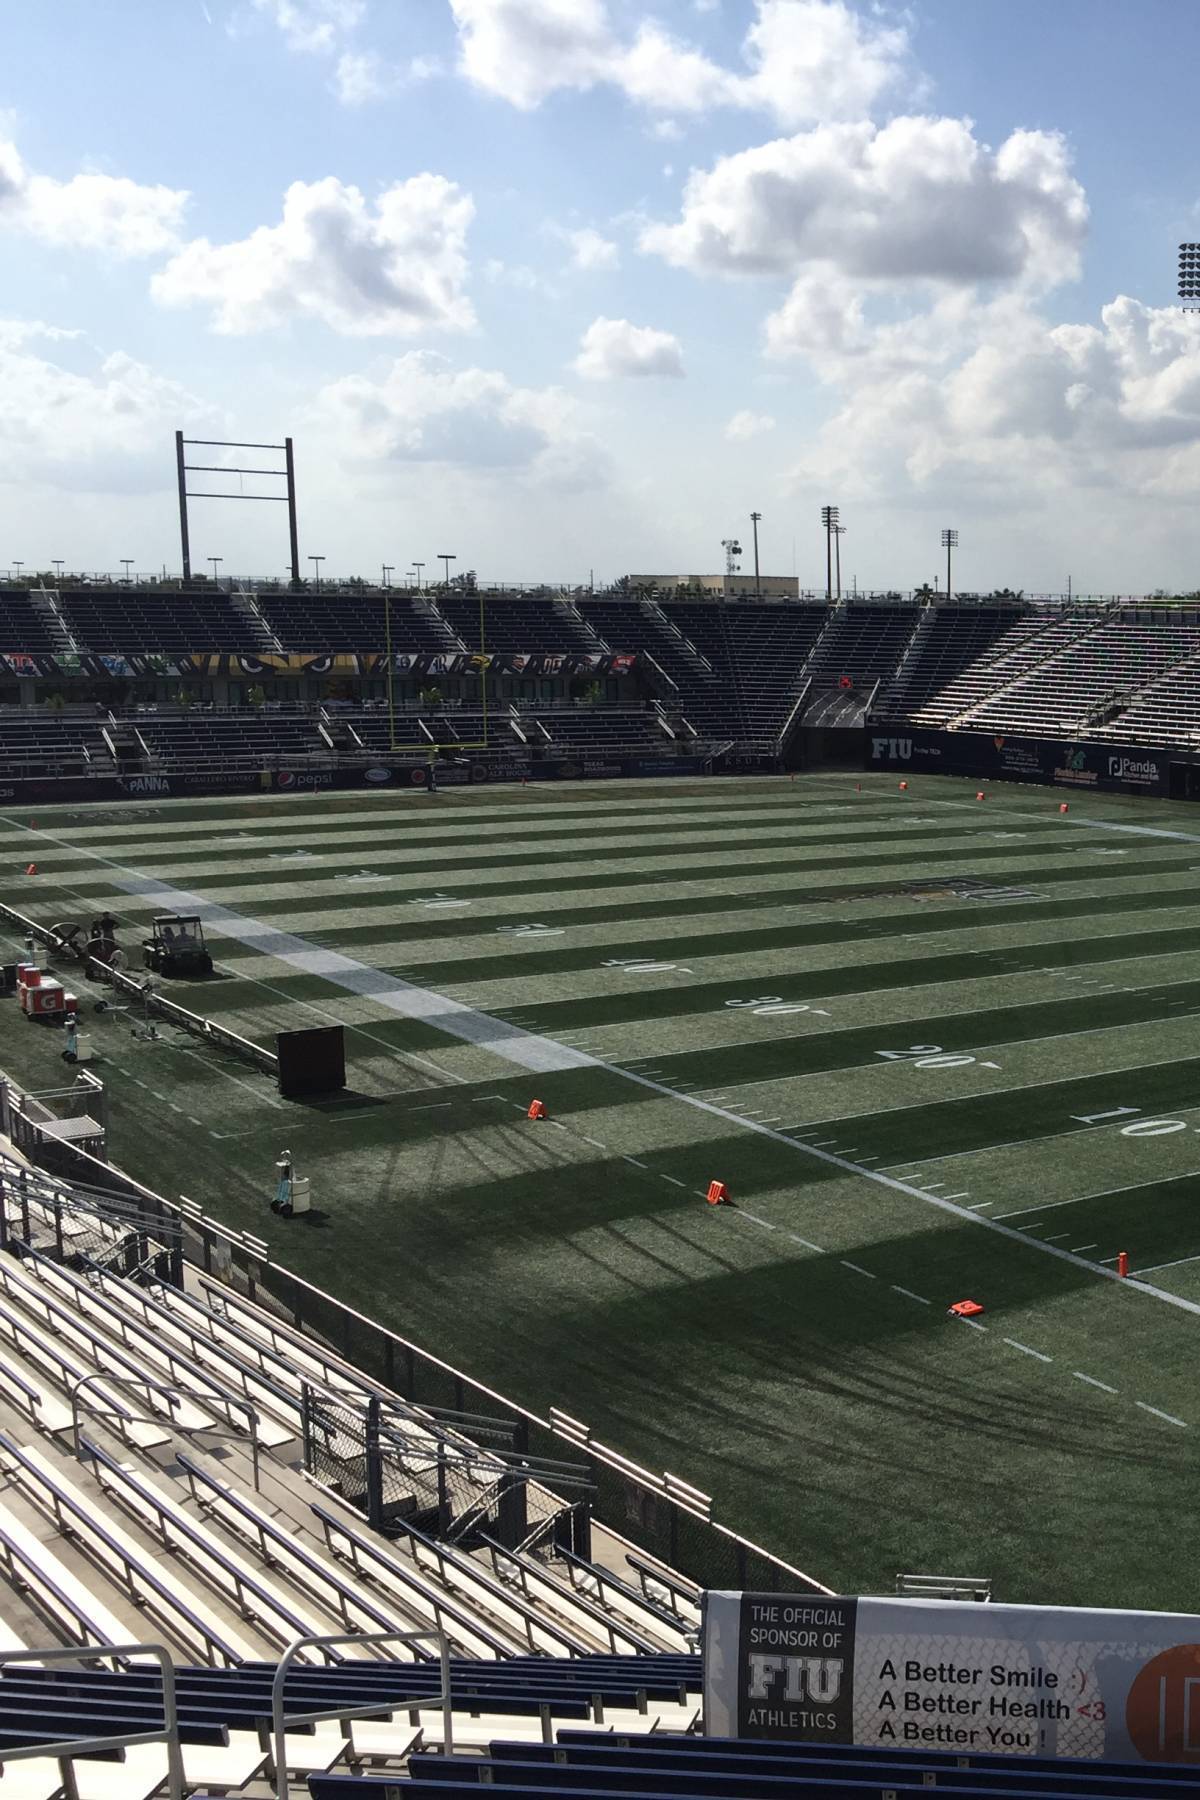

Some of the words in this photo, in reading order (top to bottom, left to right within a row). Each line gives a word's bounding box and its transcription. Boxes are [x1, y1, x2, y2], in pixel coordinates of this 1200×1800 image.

[872, 738, 912, 759] FIU
[1123, 758, 1156, 773] Panda
[129, 776, 170, 792] PANNA
[297, 772, 332, 786] pepsi
[600, 957, 677, 973] 40
[40, 994, 56, 1009] G
[724, 995, 810, 1016] 30
[874, 1044, 976, 1069] 20
[1070, 1105, 1188, 1137] 10
[751, 1605, 780, 1623] THE
[783, 1607, 846, 1627] OFFICIAL
[750, 1628, 818, 1648] SPONSOR
[822, 1632, 842, 1650] OF
[748, 1652, 844, 1704] FIU
[879, 1659, 897, 1681] A
[905, 1661, 983, 1686] Better
[989, 1664, 1059, 1690] Smile
[879, 1690, 897, 1711] A
[904, 1691, 982, 1717] Better
[989, 1695, 1071, 1721] Health
[748, 1708, 838, 1731] ATHLETICS
[879, 1721, 896, 1741] A
[903, 1722, 981, 1746] Better
